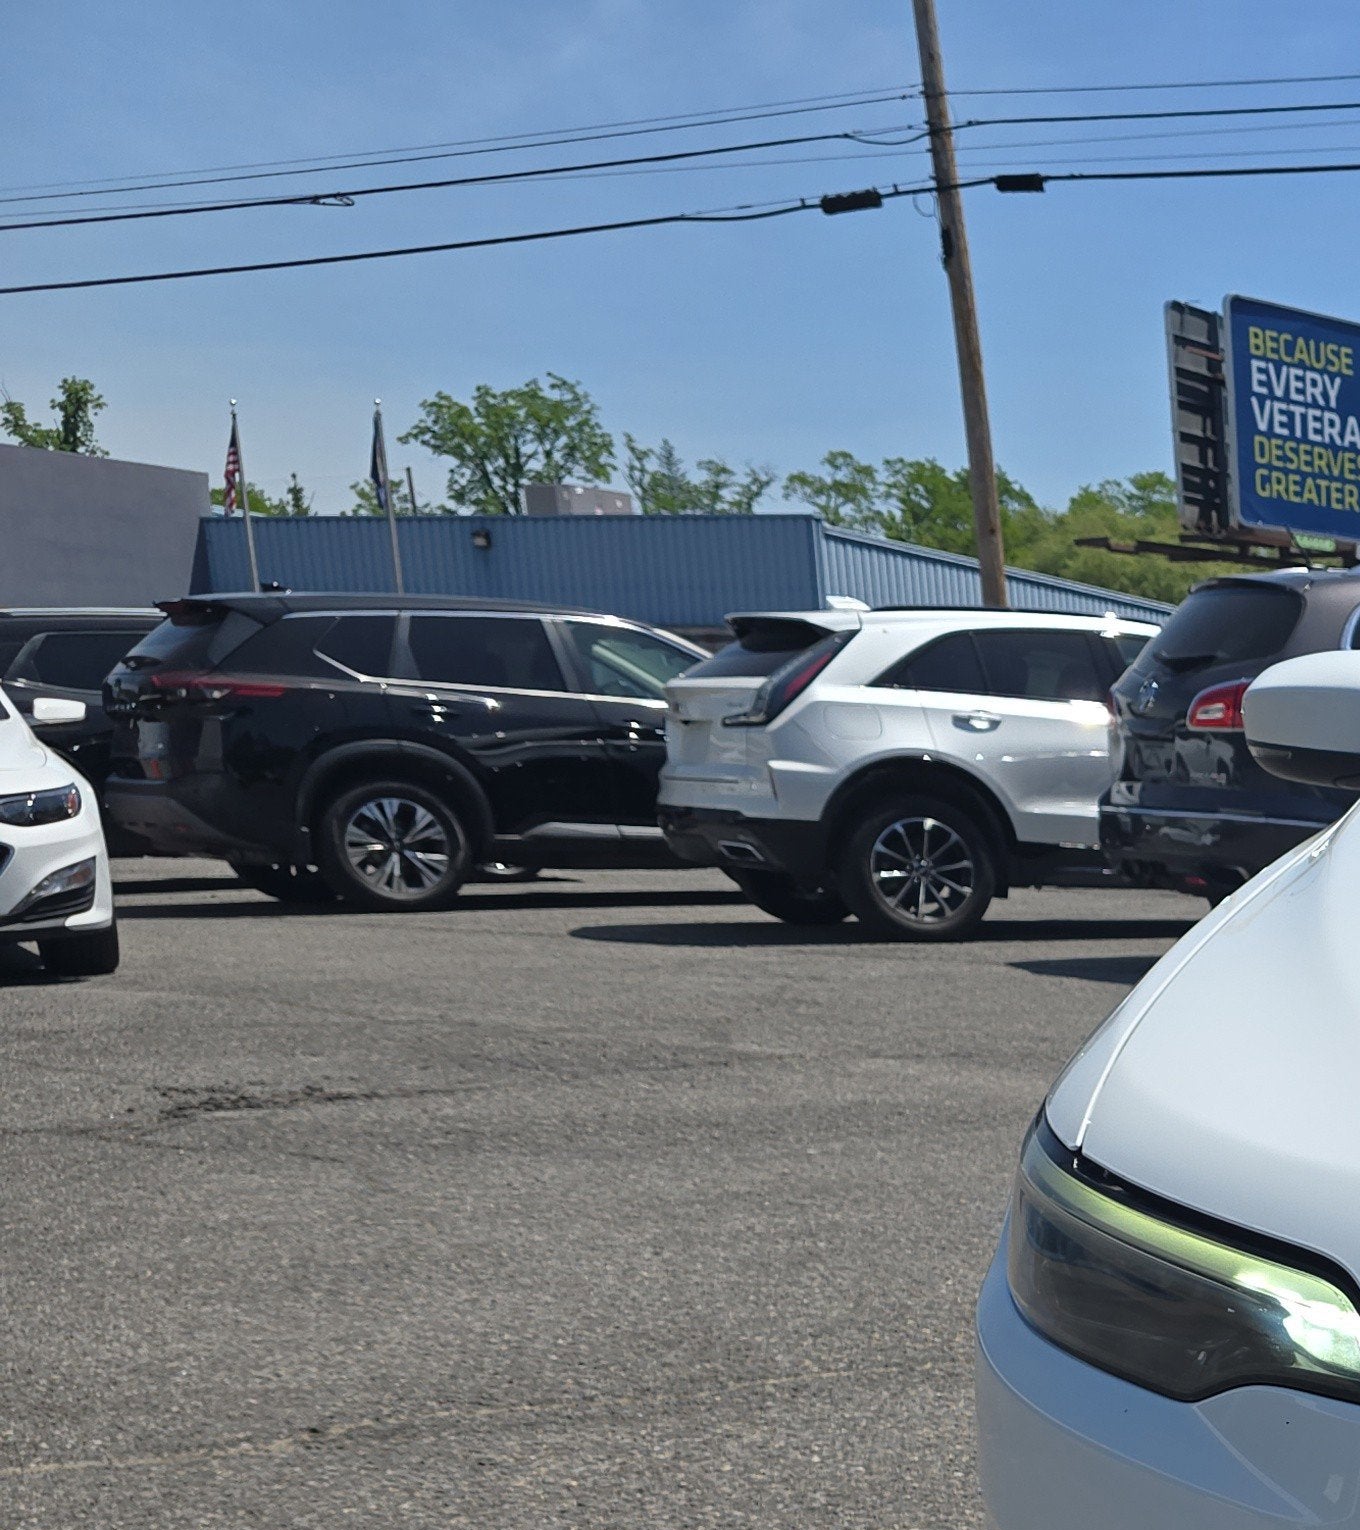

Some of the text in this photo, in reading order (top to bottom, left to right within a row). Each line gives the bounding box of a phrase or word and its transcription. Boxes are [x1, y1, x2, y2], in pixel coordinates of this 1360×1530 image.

[1248, 326, 1354, 377] BECAUSE
[1250, 359, 1342, 410] EVERY
[1255, 468, 1360, 511] GREATER
